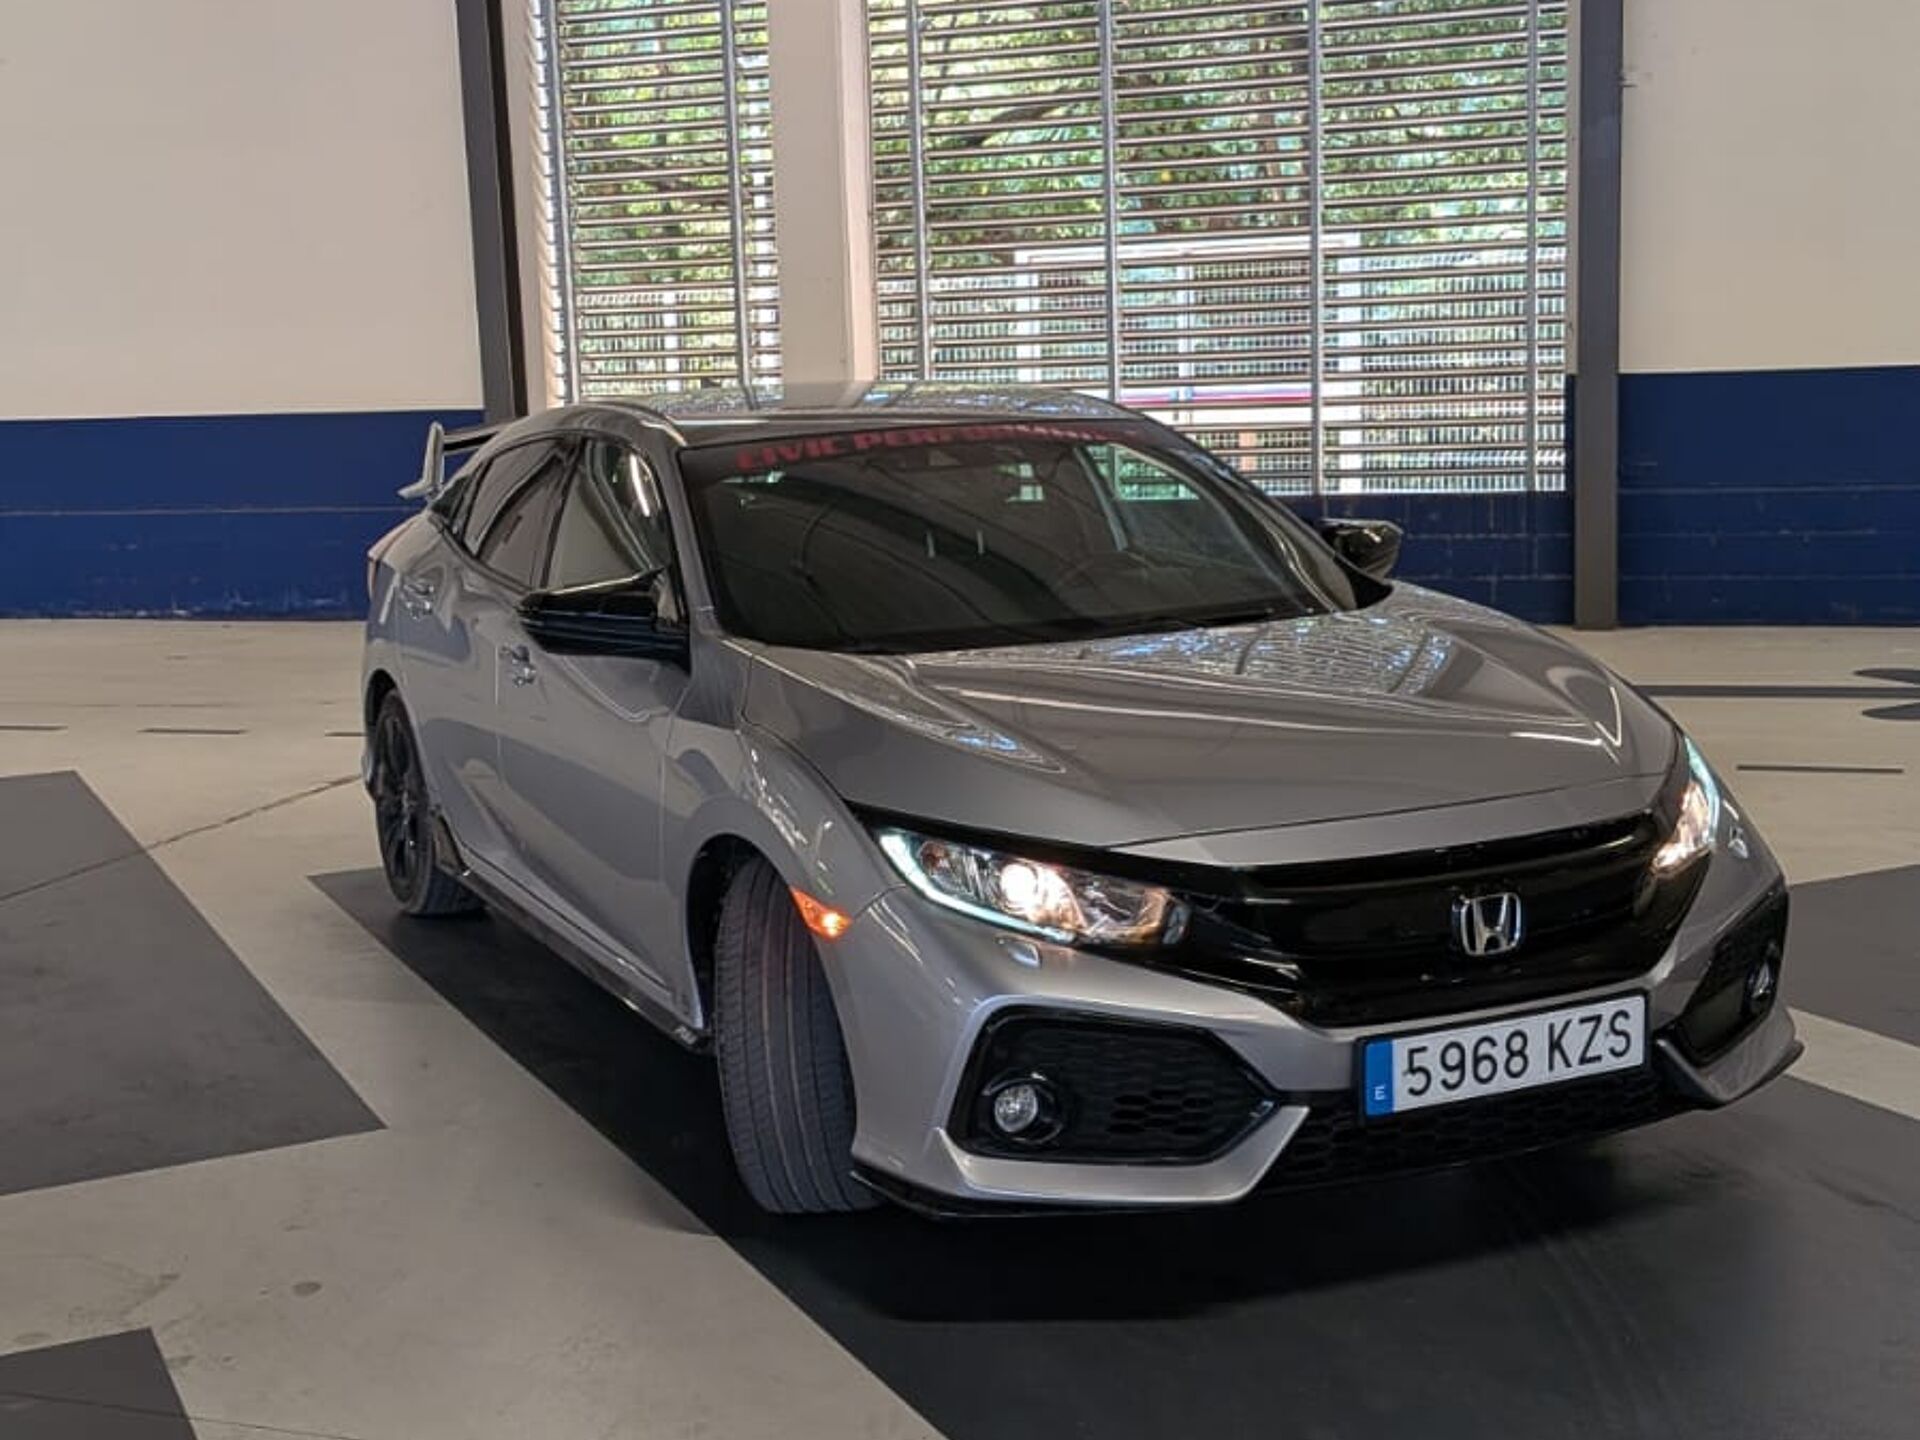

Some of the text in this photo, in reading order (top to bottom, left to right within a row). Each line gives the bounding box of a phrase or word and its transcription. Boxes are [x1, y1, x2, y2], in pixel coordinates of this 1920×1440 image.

[1403, 1009, 1632, 1096] 5968 KZS
[1374, 1085, 1386, 1101] E
